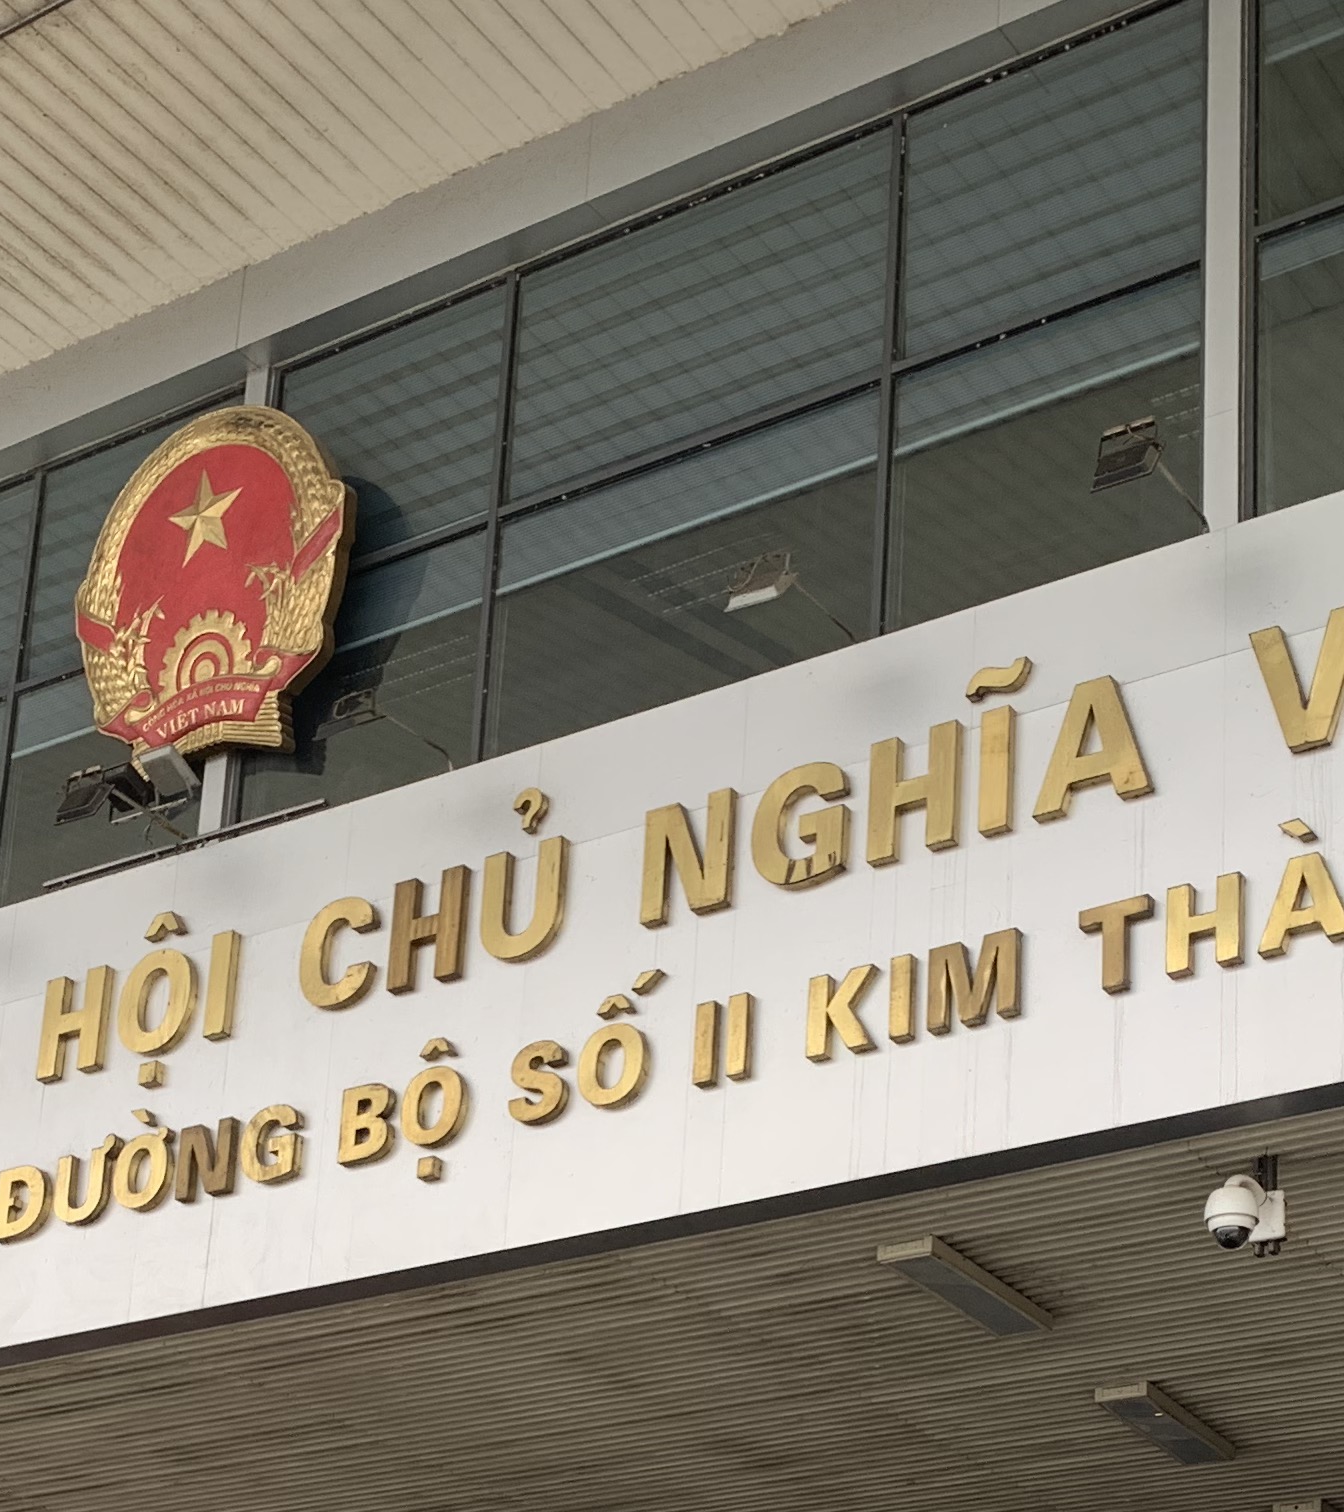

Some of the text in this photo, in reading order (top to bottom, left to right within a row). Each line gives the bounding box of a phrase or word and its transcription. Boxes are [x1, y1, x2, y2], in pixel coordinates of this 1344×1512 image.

[203, 699, 245, 720] NAM
[36, 911, 242, 1090] HỘI
[299, 787, 571, 1010] CHỦ
[638, 655, 1155, 931] NGHĨA
[336, 1036, 470, 1183] BỘ
[508, 968, 666, 1126] SỐ
[692, 991, 753, 1089] II
[805, 927, 1025, 1063] KIM
